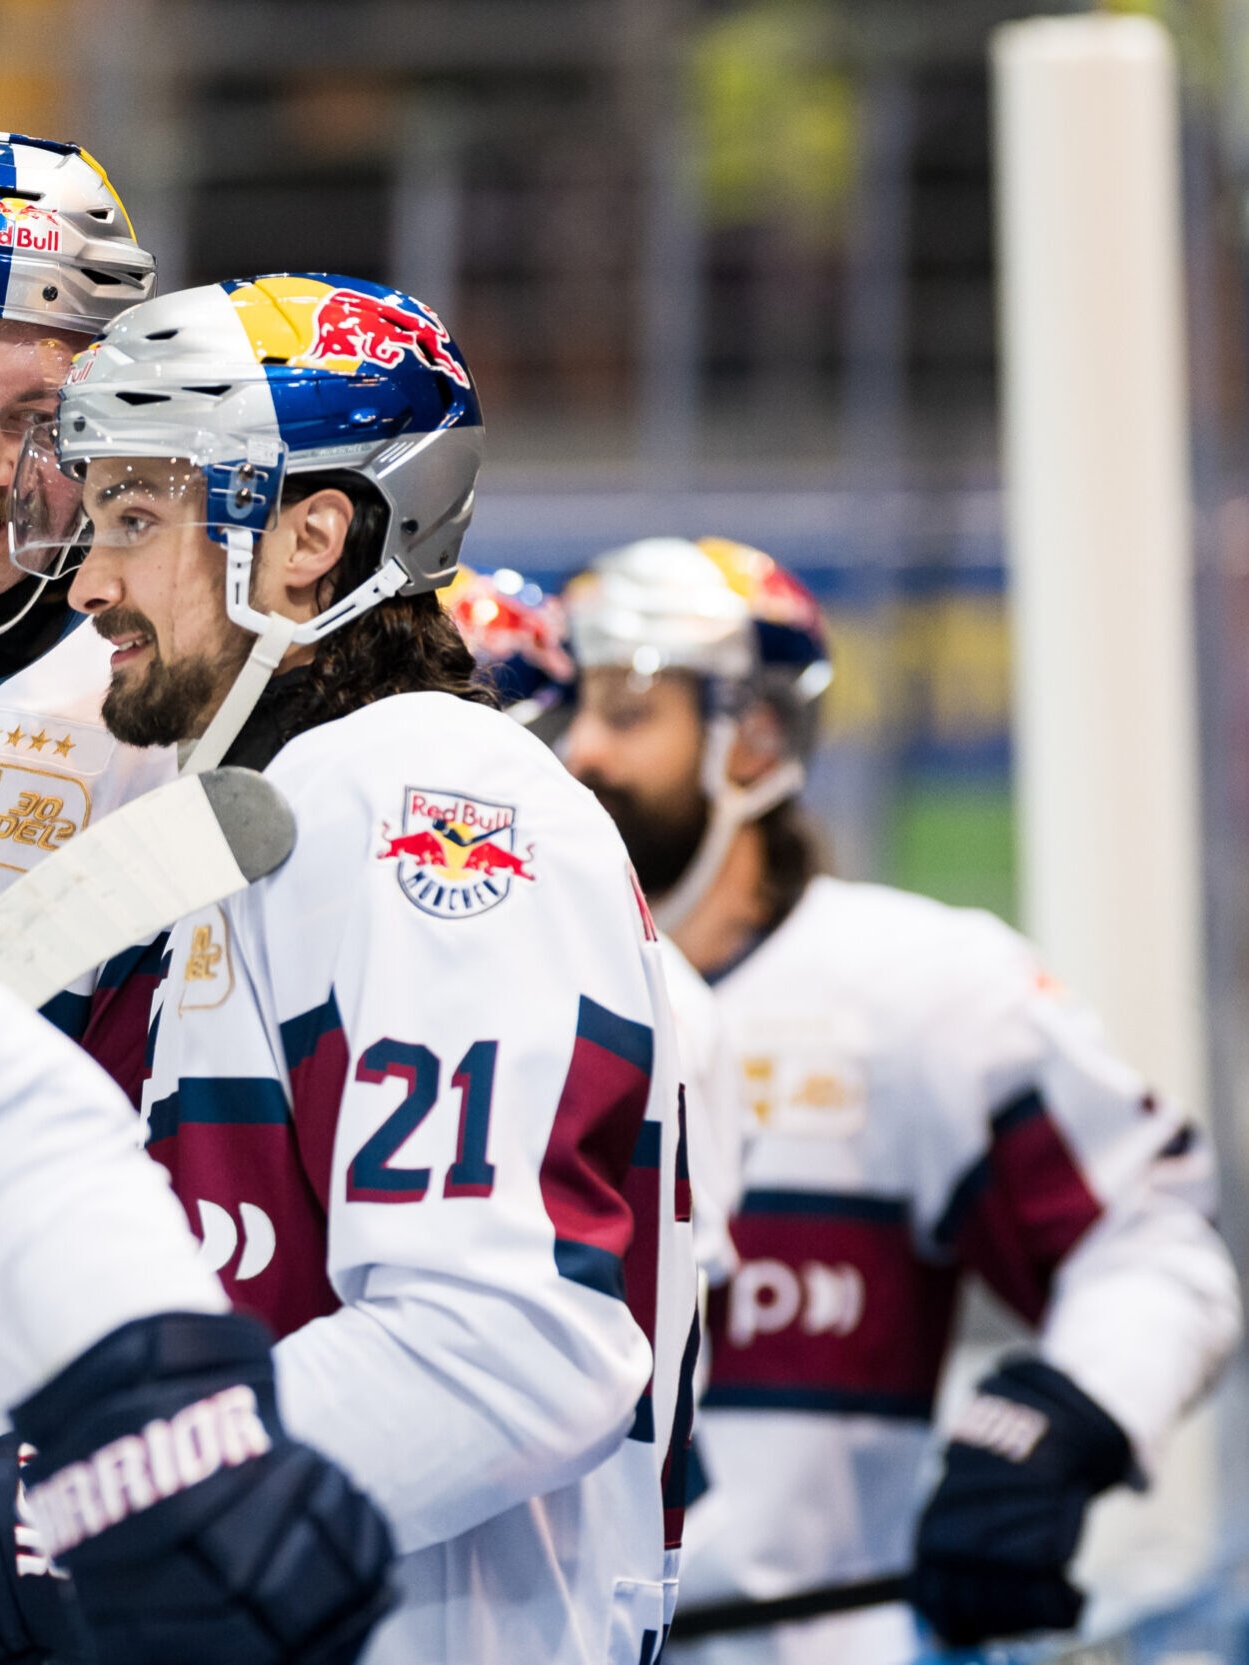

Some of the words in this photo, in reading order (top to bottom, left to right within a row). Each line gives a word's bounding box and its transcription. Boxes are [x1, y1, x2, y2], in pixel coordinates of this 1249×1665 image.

[16, 227, 59, 252] Bull
[8, 791, 64, 820] 30
[412, 795, 459, 823] Red
[463, 803, 510, 831] Bull
[346, 1038, 500, 1204] 21
